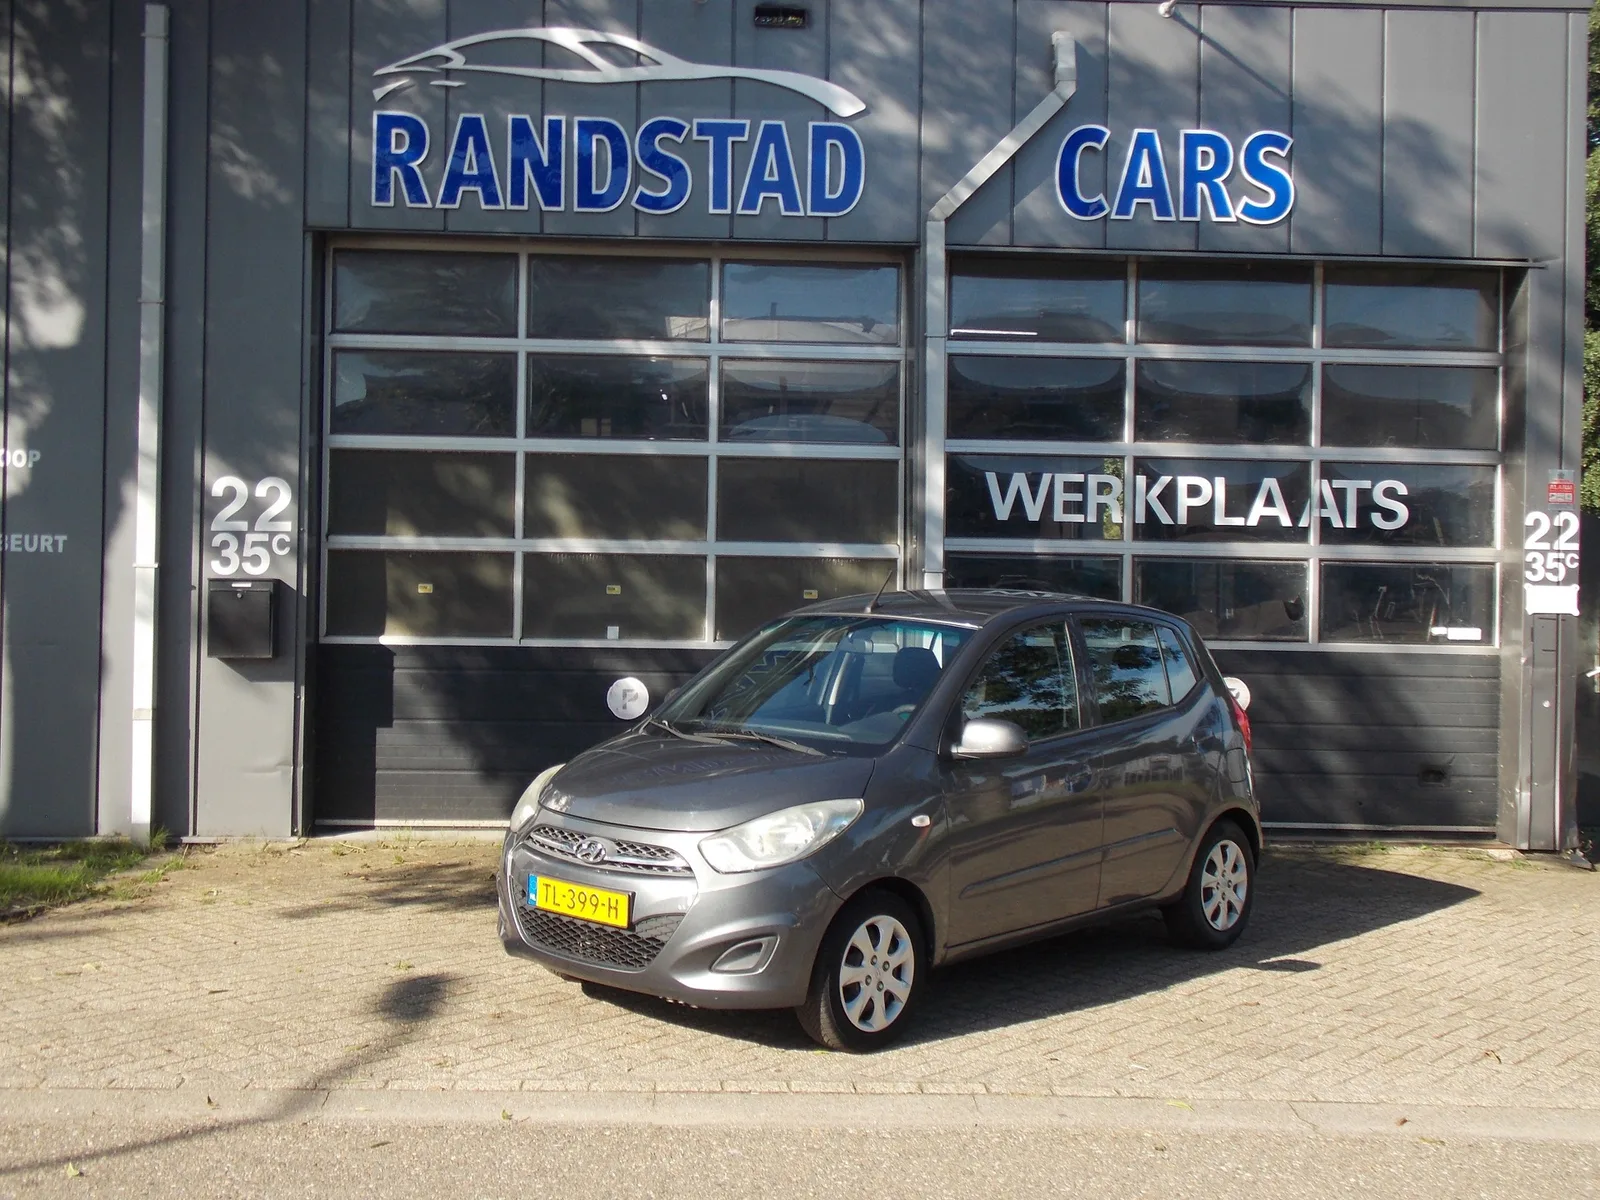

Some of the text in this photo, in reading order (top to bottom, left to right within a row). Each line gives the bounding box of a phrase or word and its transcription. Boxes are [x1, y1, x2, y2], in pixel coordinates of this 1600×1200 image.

[371, 110, 1295, 225] RANDSTAD CARS
[210, 475, 292, 532] 22
[985, 471, 1409, 530] WERKPLAATS
[1524, 511, 1580, 550] 22
[542, 882, 619, 920] TL-399-H
